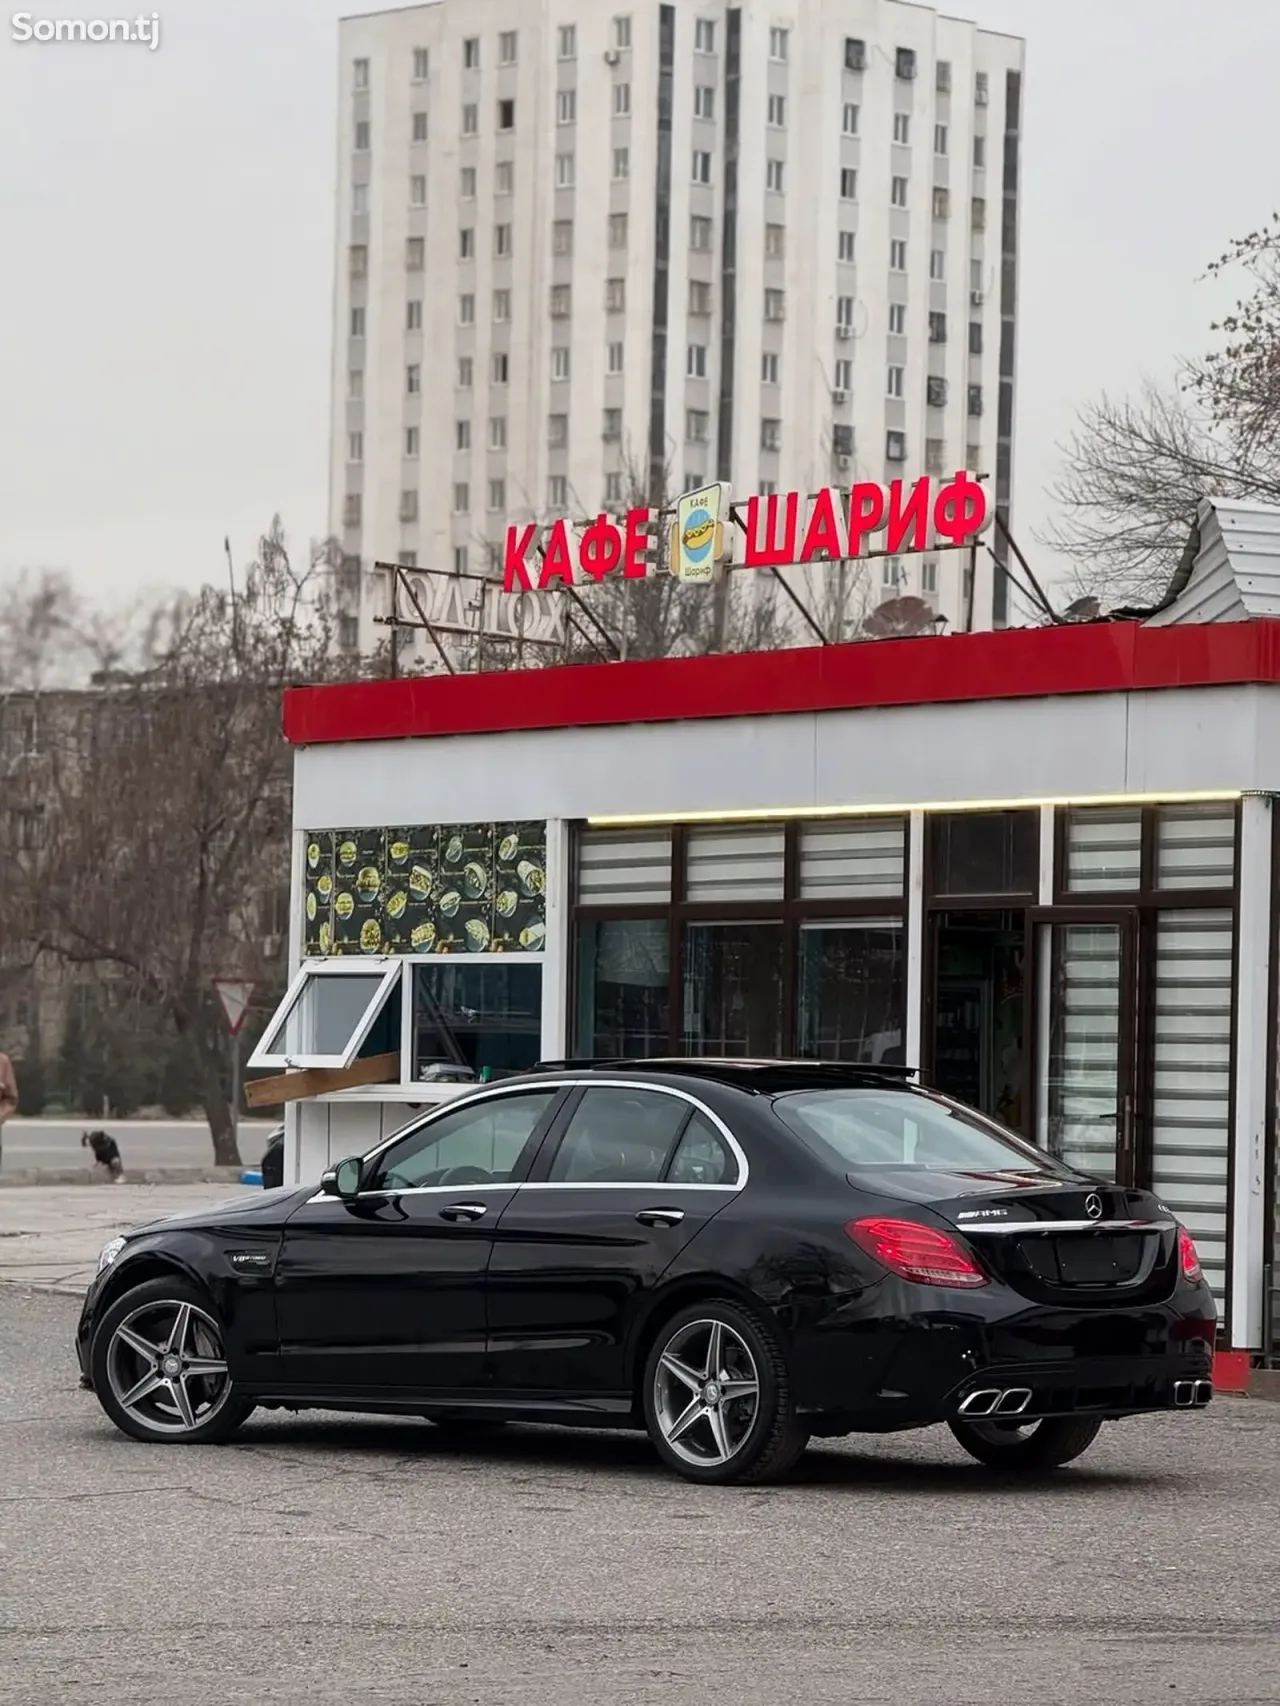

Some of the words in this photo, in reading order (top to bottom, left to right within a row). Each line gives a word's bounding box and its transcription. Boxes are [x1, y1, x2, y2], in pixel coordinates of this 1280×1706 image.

[502, 507, 652, 592] КАФЕ
[744, 471, 988, 568] ШАРИФ
[690, 497, 709, 508] КАФЕ
